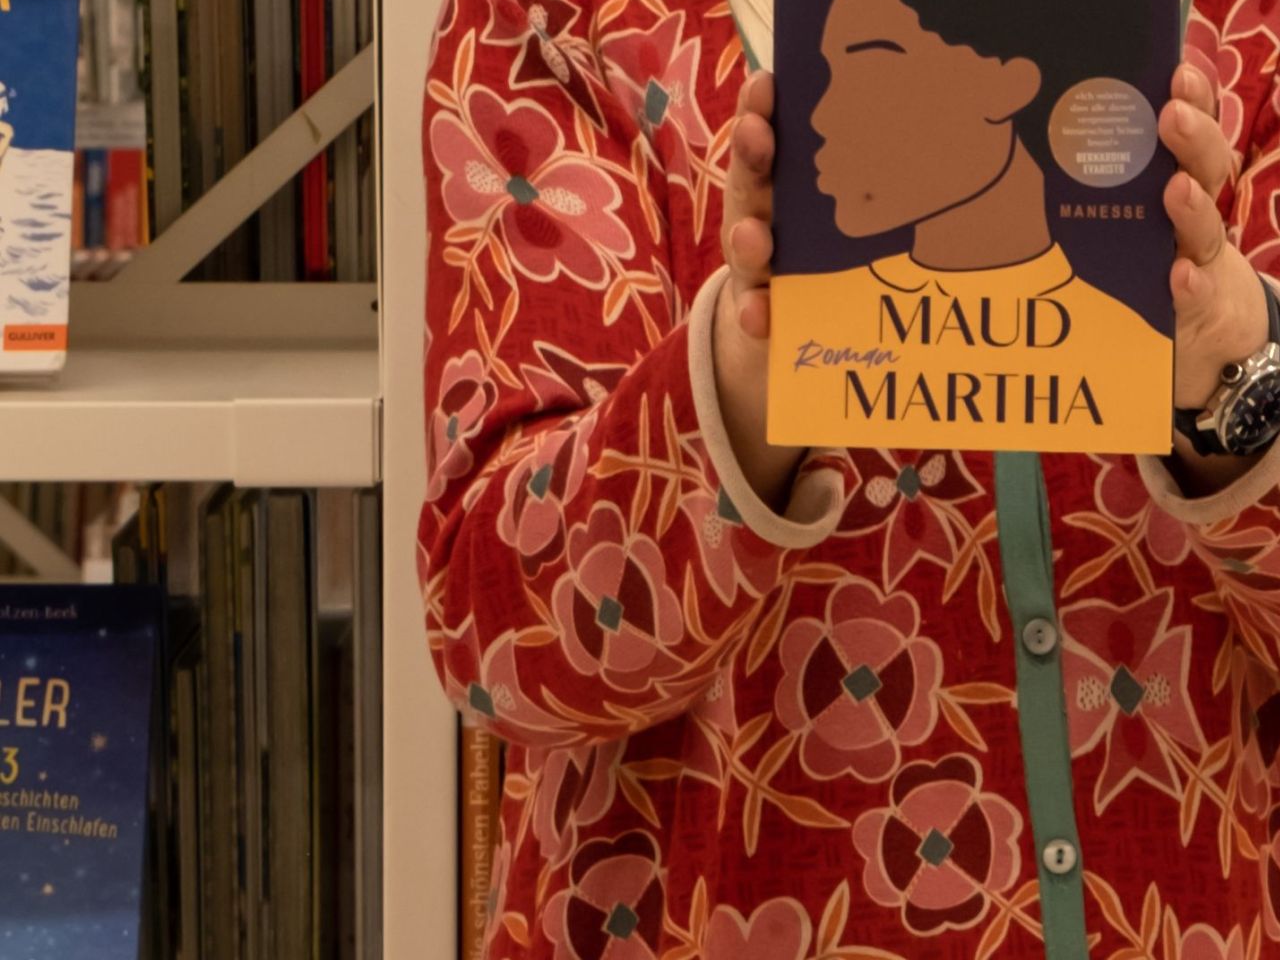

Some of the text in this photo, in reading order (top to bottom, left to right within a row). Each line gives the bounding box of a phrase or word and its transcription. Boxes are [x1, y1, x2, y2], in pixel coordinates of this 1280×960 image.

[1059, 204, 1146, 219] MANESSE
[878, 295, 1072, 348] MAUD
[793, 340, 903, 372] Roman
[844, 370, 1105, 426] MARTHA
[469, 729, 490, 806] Fabeln
[26, 811, 118, 839] Einschlafen
